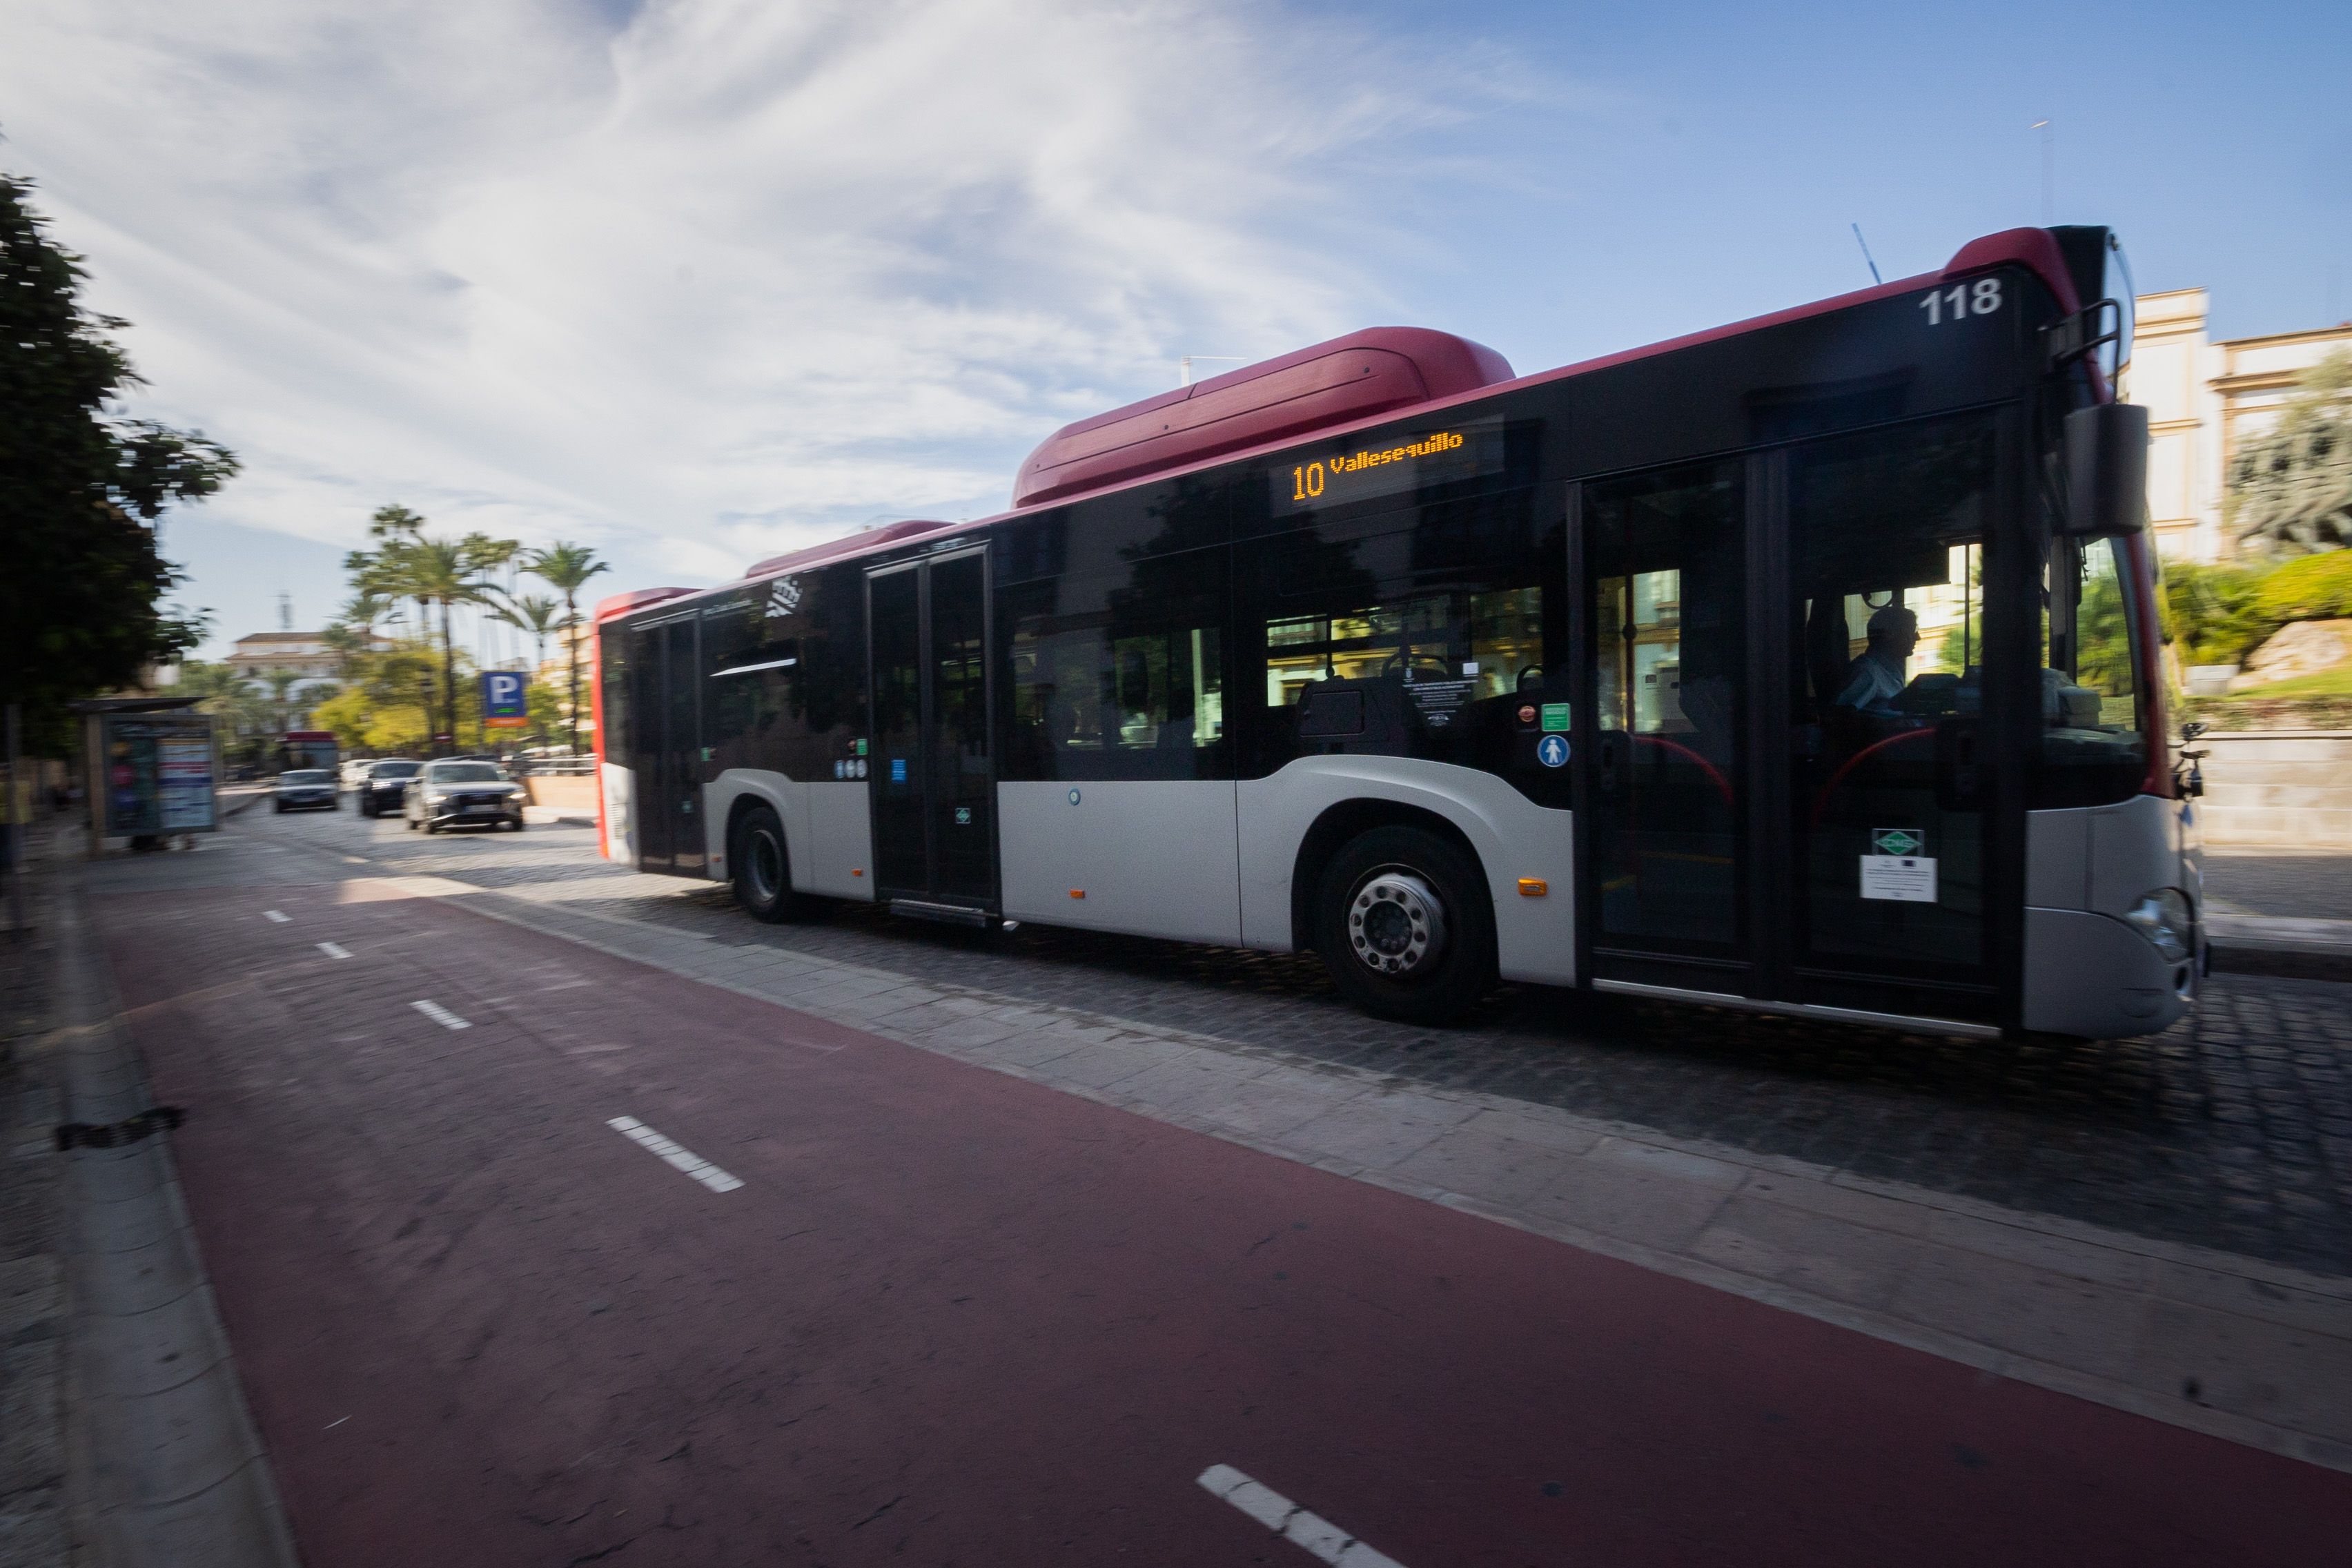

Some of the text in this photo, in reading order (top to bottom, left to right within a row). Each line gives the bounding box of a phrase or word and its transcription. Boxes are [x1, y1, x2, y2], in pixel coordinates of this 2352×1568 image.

[1919, 277, 2003, 326] 118
[1293, 432, 1464, 500] 10 Vallesequillo
[489, 676, 518, 704] P
